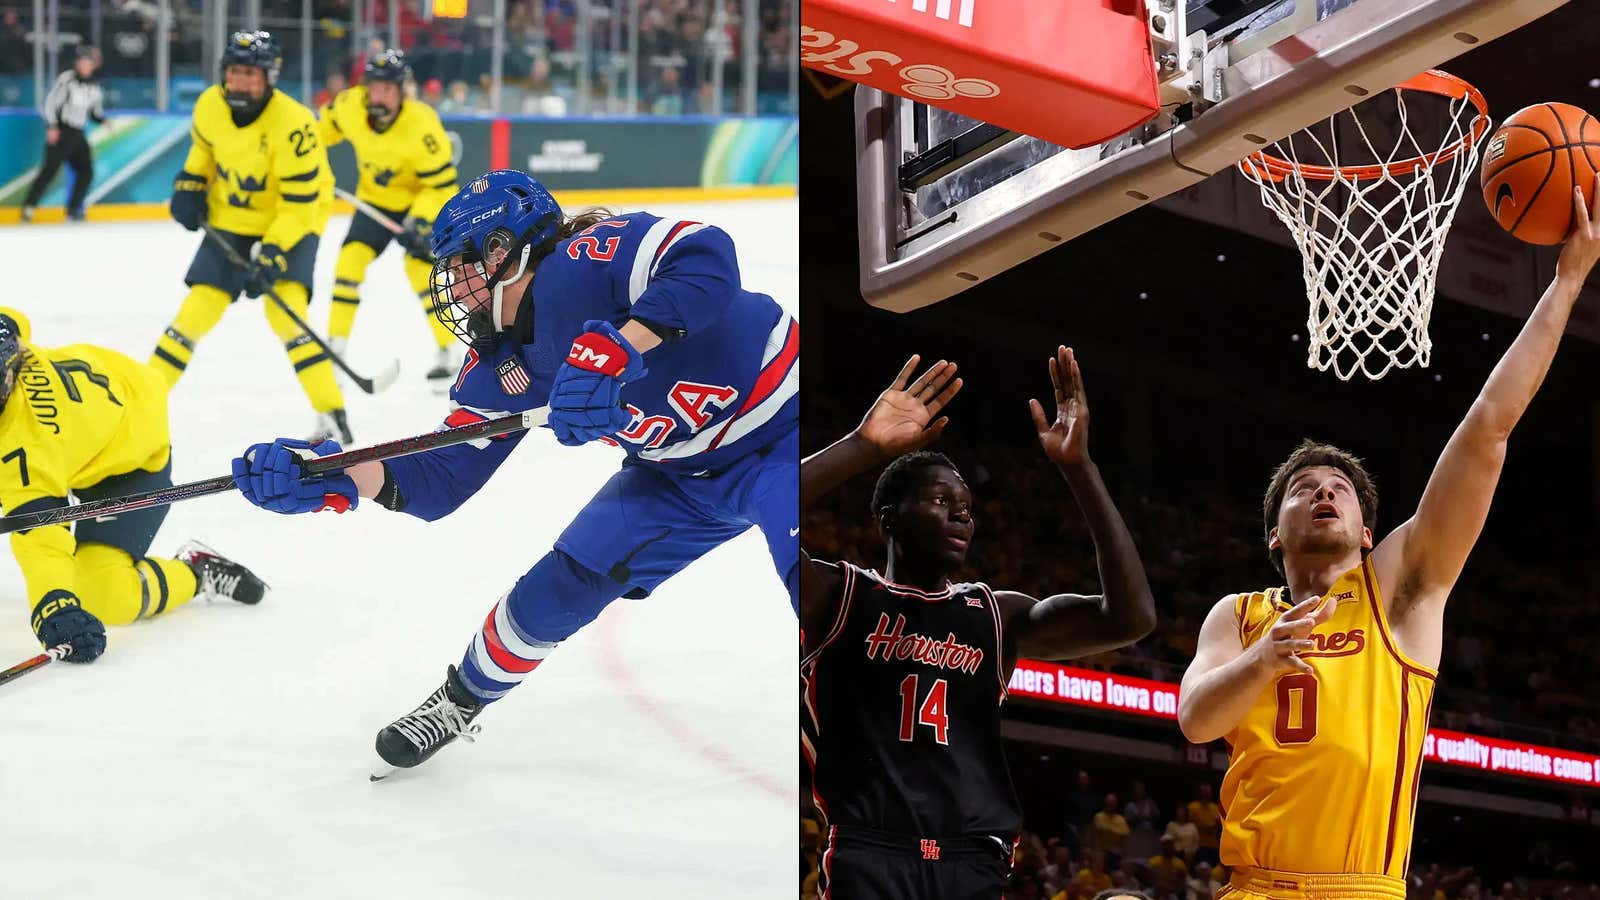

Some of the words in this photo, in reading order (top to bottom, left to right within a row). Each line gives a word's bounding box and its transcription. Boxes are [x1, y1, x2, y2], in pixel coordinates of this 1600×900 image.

[472, 206, 503, 225] CCM
[50, 359, 124, 407] 7
[499, 360, 516, 375] USA
[22, 350, 60, 434] JUNGH
[600, 381, 738, 448] SA
[1, 447, 30, 487] 7
[33, 598, 77, 634] CCM
[865, 612, 983, 675] Houston
[899, 674, 948, 745] 14
[1009, 668, 1054, 695] ners
[1058, 669, 1103, 703] have
[1106, 678, 1149, 710] Iowa
[1153, 690, 1176, 715] on
[1274, 673, 1317, 745] 0
[1437, 737, 1489, 768] quality
[1491, 746, 1552, 776] proteins
[1553, 757, 1592, 782] come
